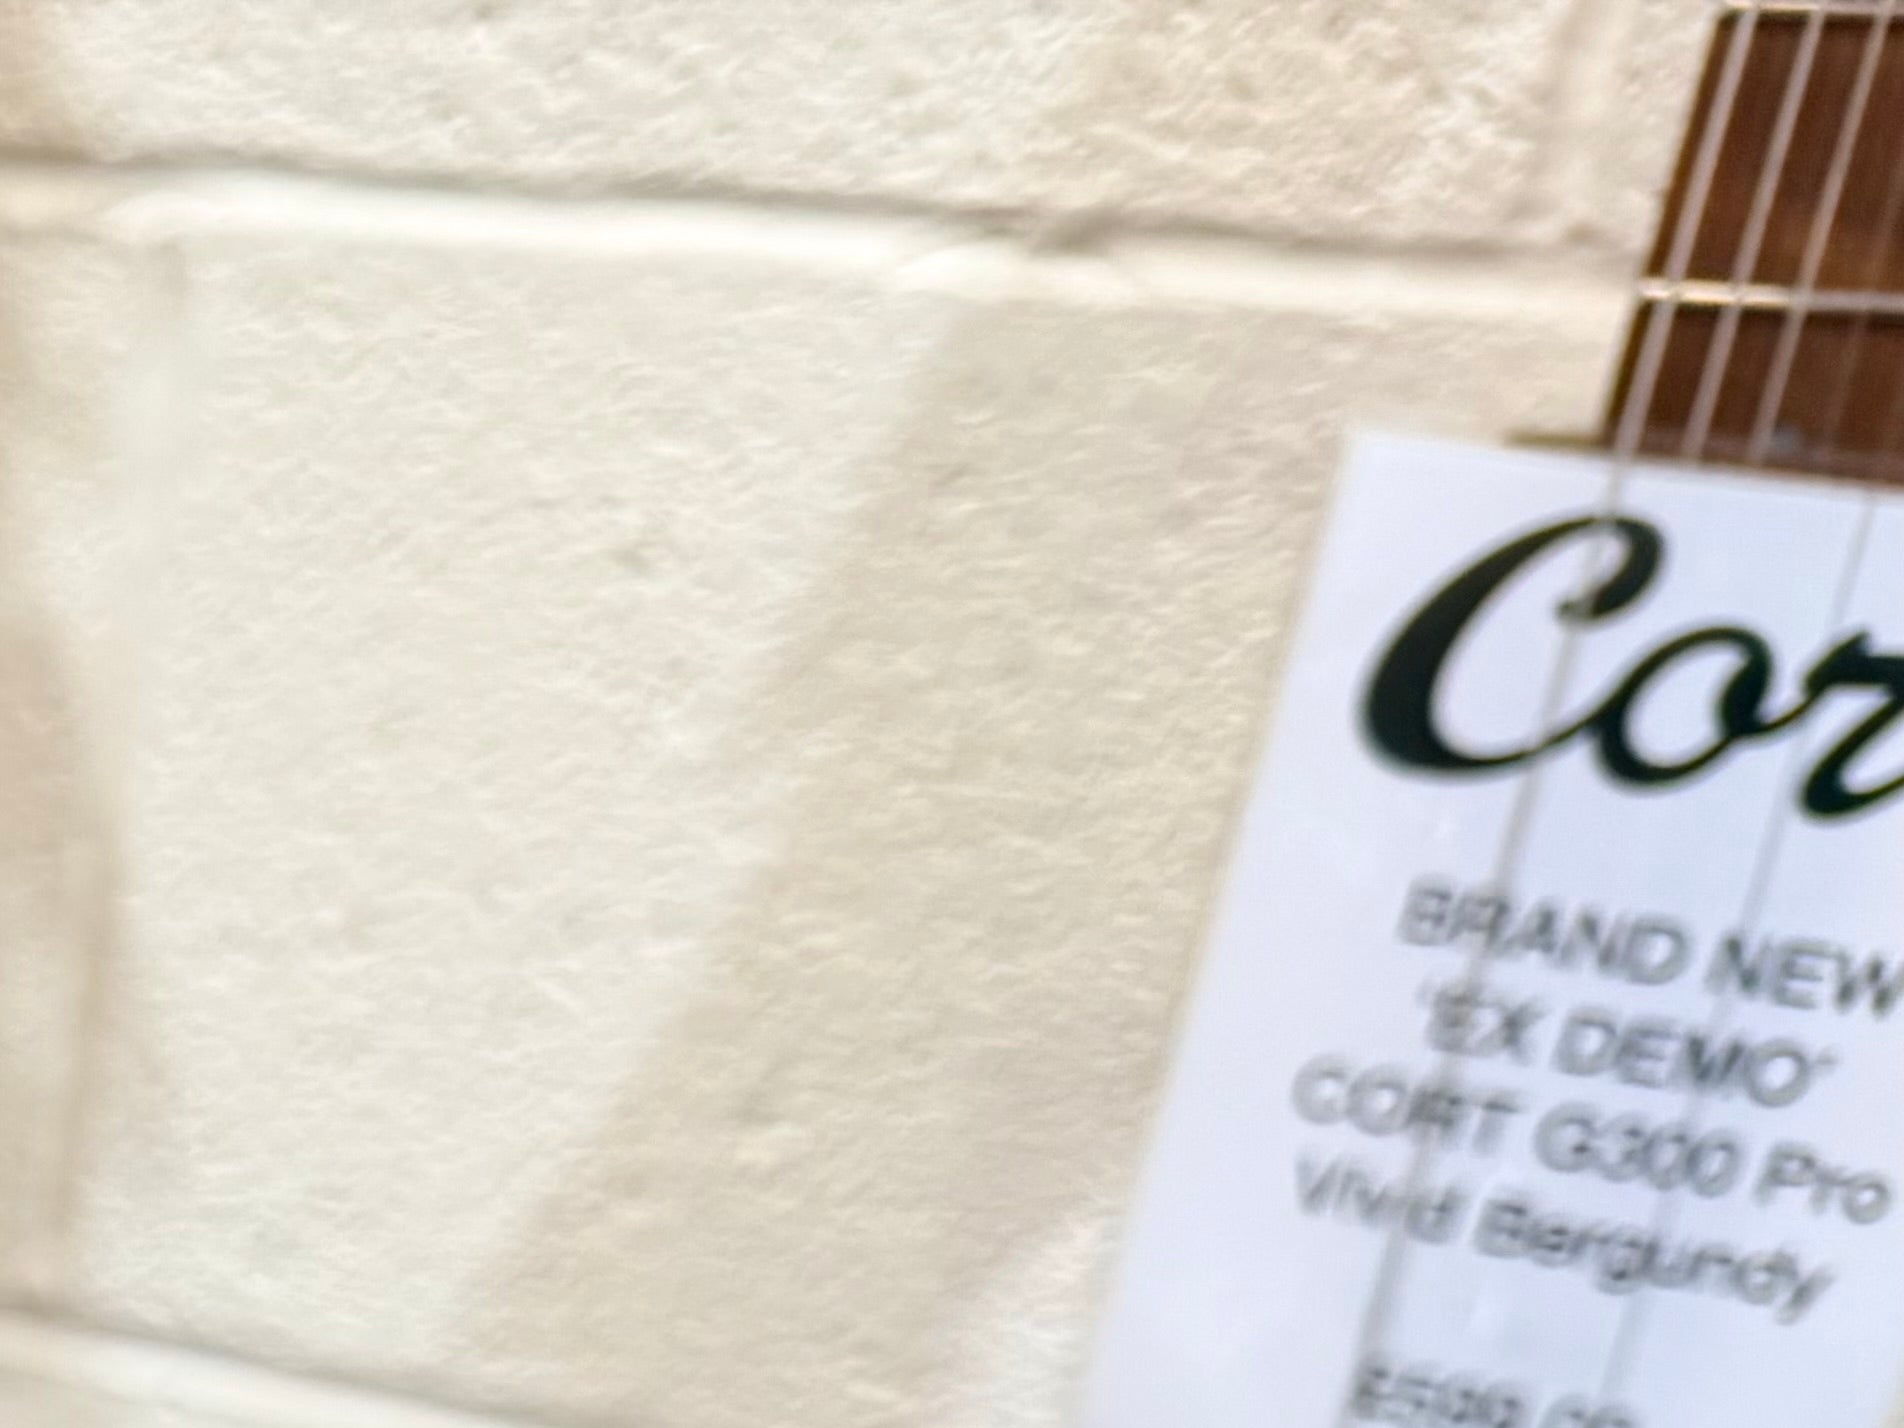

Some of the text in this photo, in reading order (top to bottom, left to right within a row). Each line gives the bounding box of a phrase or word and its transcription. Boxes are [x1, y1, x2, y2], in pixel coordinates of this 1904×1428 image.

[1395, 873, 1904, 1020] BRAND NEW
[1291, 1052, 1892, 1226] CORT G300 Pro
[1292, 1150, 1462, 1246] Vivid
